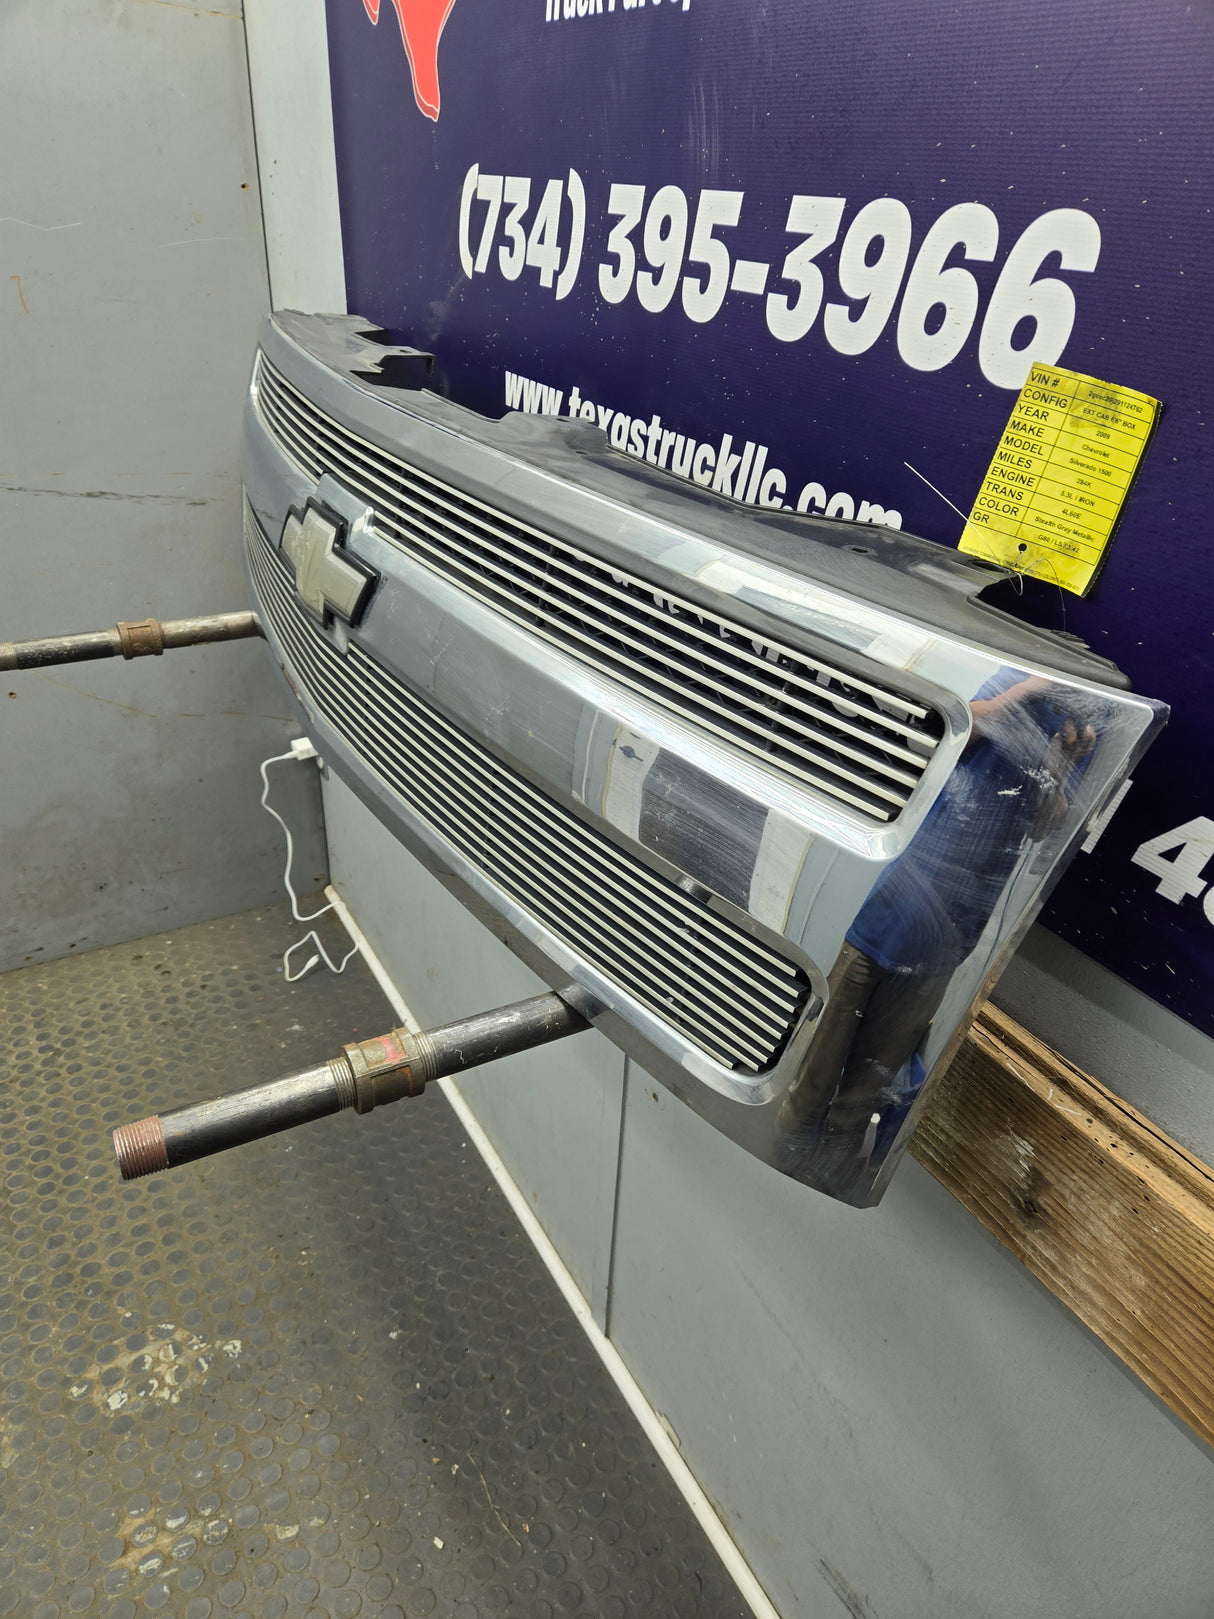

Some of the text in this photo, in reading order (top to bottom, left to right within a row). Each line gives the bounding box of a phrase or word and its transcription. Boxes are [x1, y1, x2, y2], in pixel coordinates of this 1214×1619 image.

[459, 163, 1101, 390] (734) 395-3966
[1031, 372, 1050, 385] VIN
[1051, 378, 1060, 387] #
[1018, 404, 1110, 440] YEAR 2009
[1023, 388, 1067, 408] CONFIG
[1082, 408, 1095, 416] EXT
[1096, 412, 1110, 421] CAB
[1122, 421, 1137, 430] BOX
[505, 371, 903, 530] wwwtexastruckllc.com
[997, 451, 1033, 469] MILES
[1003, 435, 1112, 477] MODEL Silverado 1500
[1010, 420, 1110, 459] MAKE Chevrolet
[986, 481, 1082, 520] TRANS 4L60E
[991, 466, 1035, 487] ENGINE
[1060, 490, 1073, 499] 5.3L
[1078, 496, 1096, 507] IRON
[973, 511, 990, 524] GR
[979, 497, 1095, 542] COLOR Stealth Gray Metallic
[1131, 816, 1214, 926] 4
